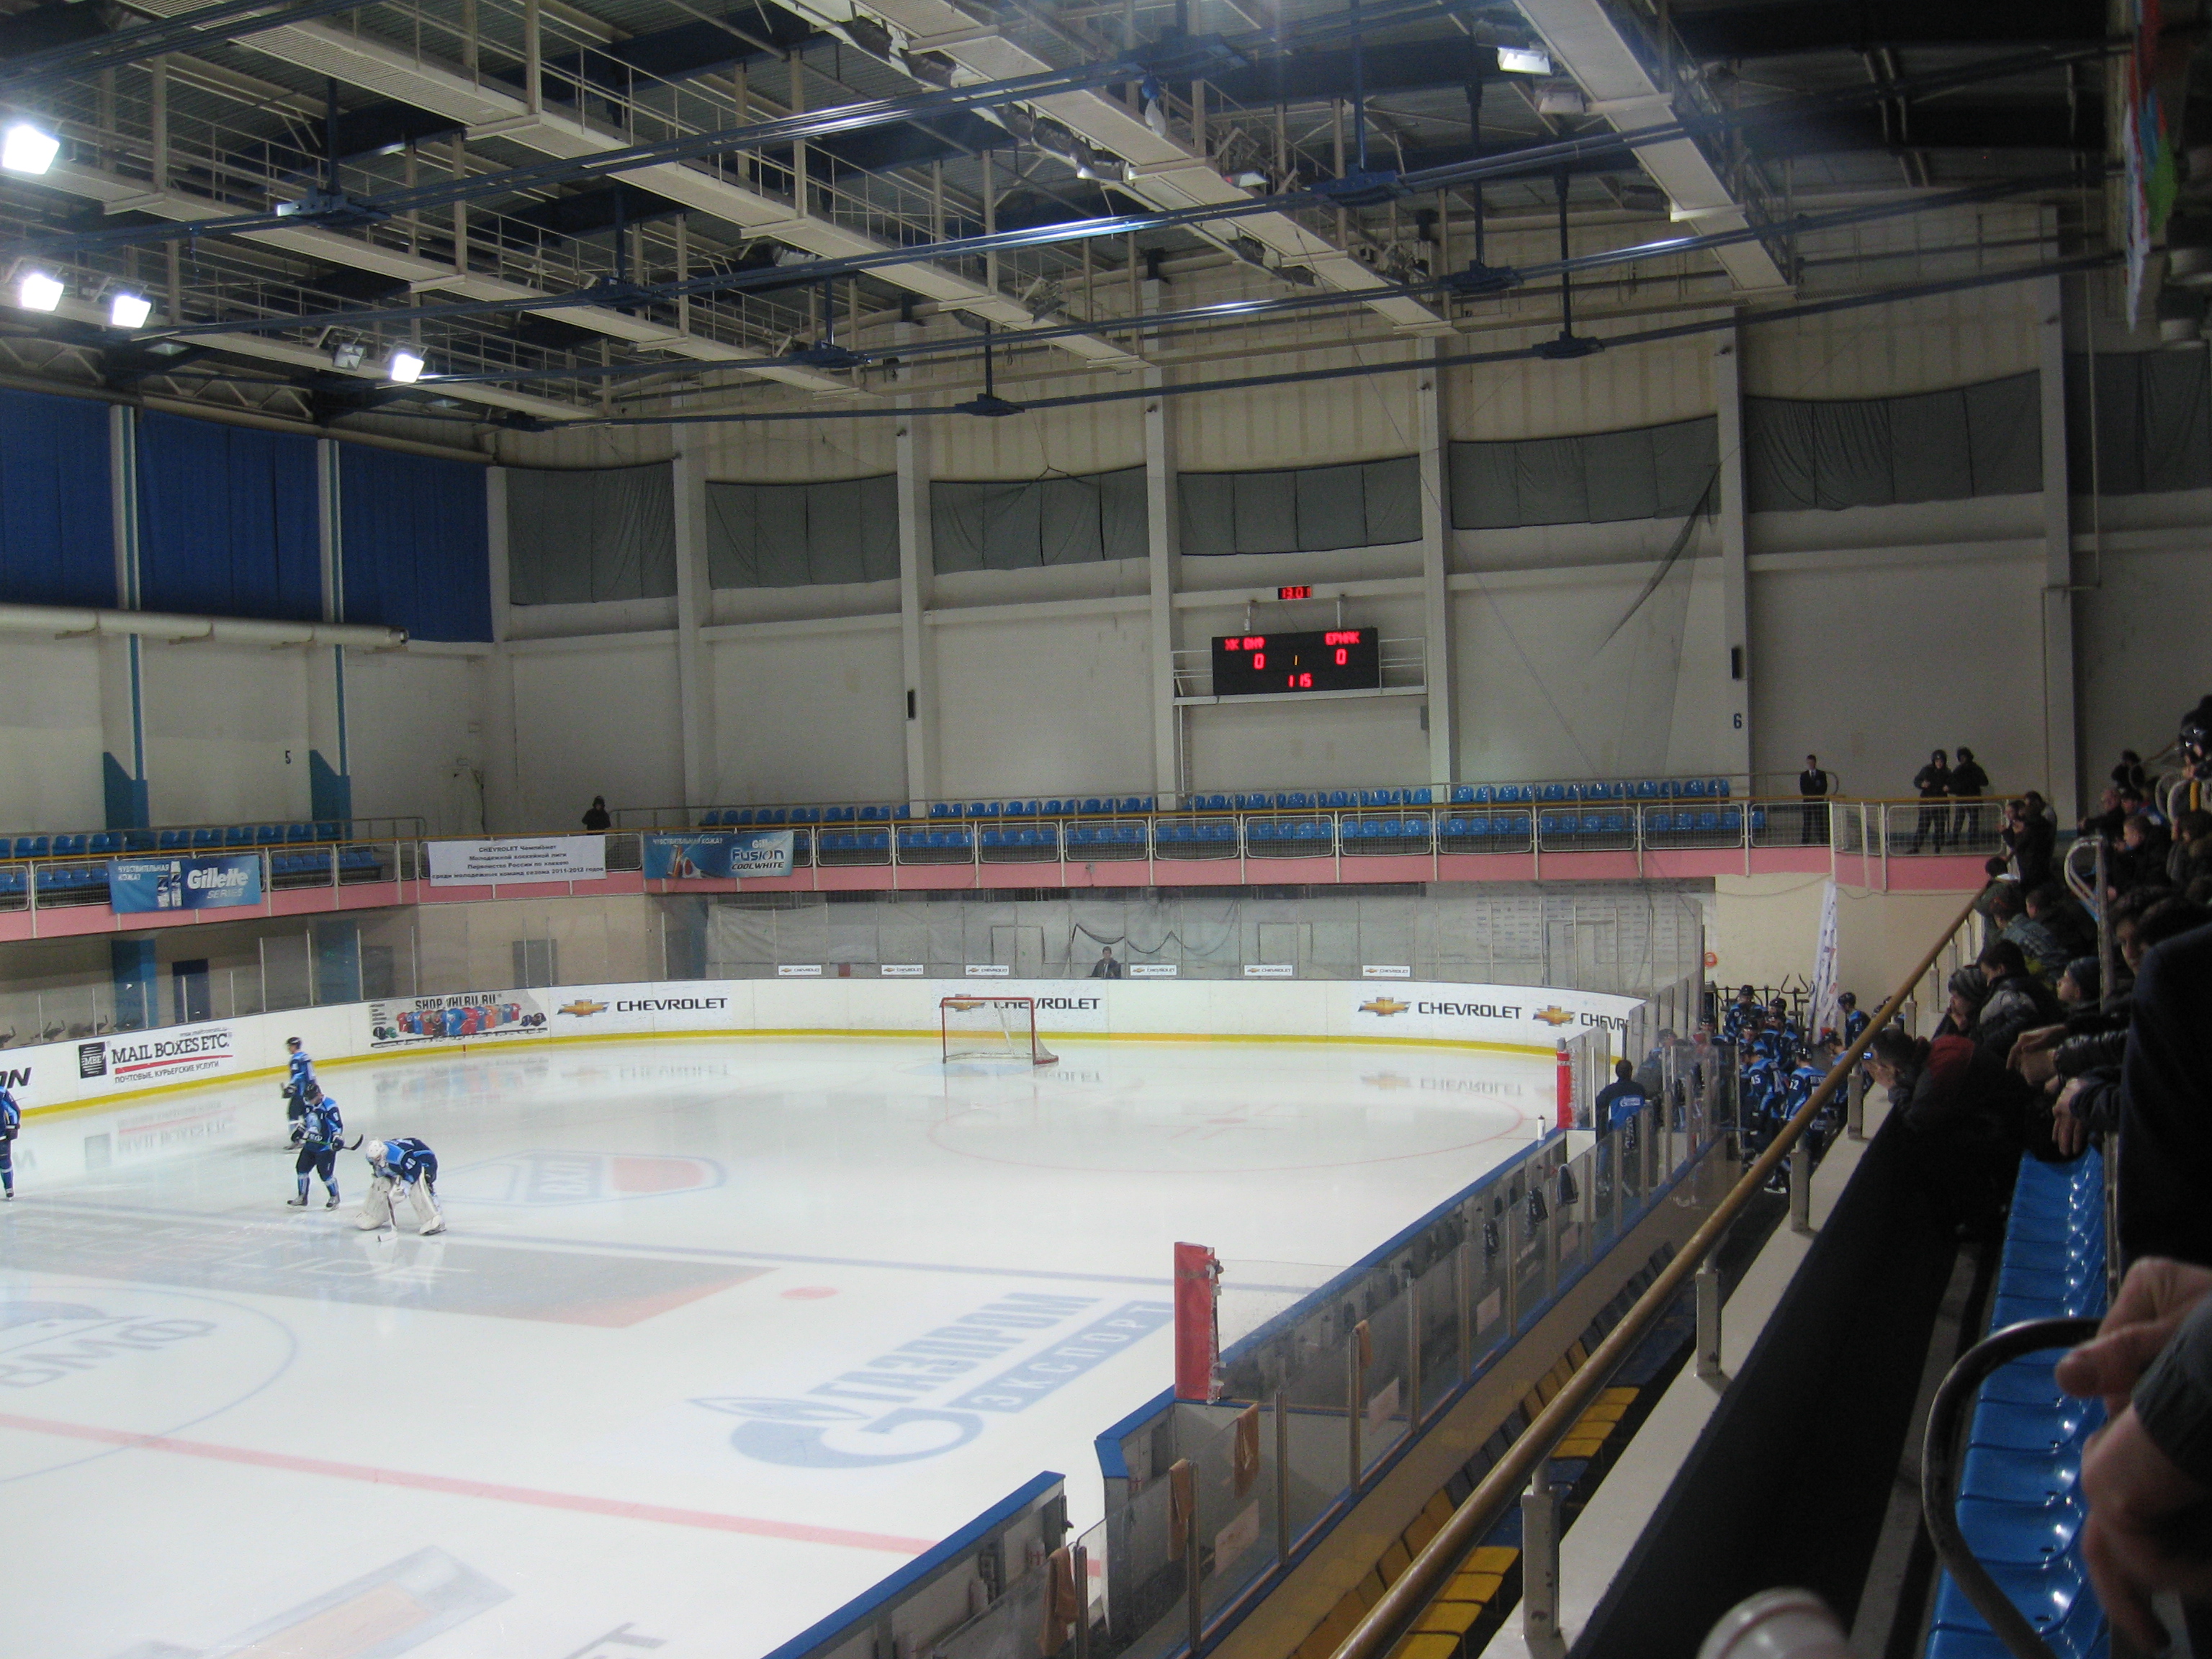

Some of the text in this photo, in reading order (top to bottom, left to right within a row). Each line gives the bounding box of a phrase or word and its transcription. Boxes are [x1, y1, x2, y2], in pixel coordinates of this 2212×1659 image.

[1253, 652, 1266, 670] 0
[1335, 648, 1348, 666] 0
[1733, 713, 1742, 729] 6
[285, 750, 291, 764] 5
[187, 867, 248, 890] Gillette
[207, 888, 244, 899] SERIES
[617, 998, 728, 1012] CHEVROLET
[1419, 1002, 1522, 1020] CHEVROLET
[112, 1044, 153, 1064] MAIL
[155, 1037, 200, 1058] BOXES
[155, 1064, 195, 1077] КУРЬЕРСКИЕ
[196, 1061, 220, 1071] УСЛУГИ
